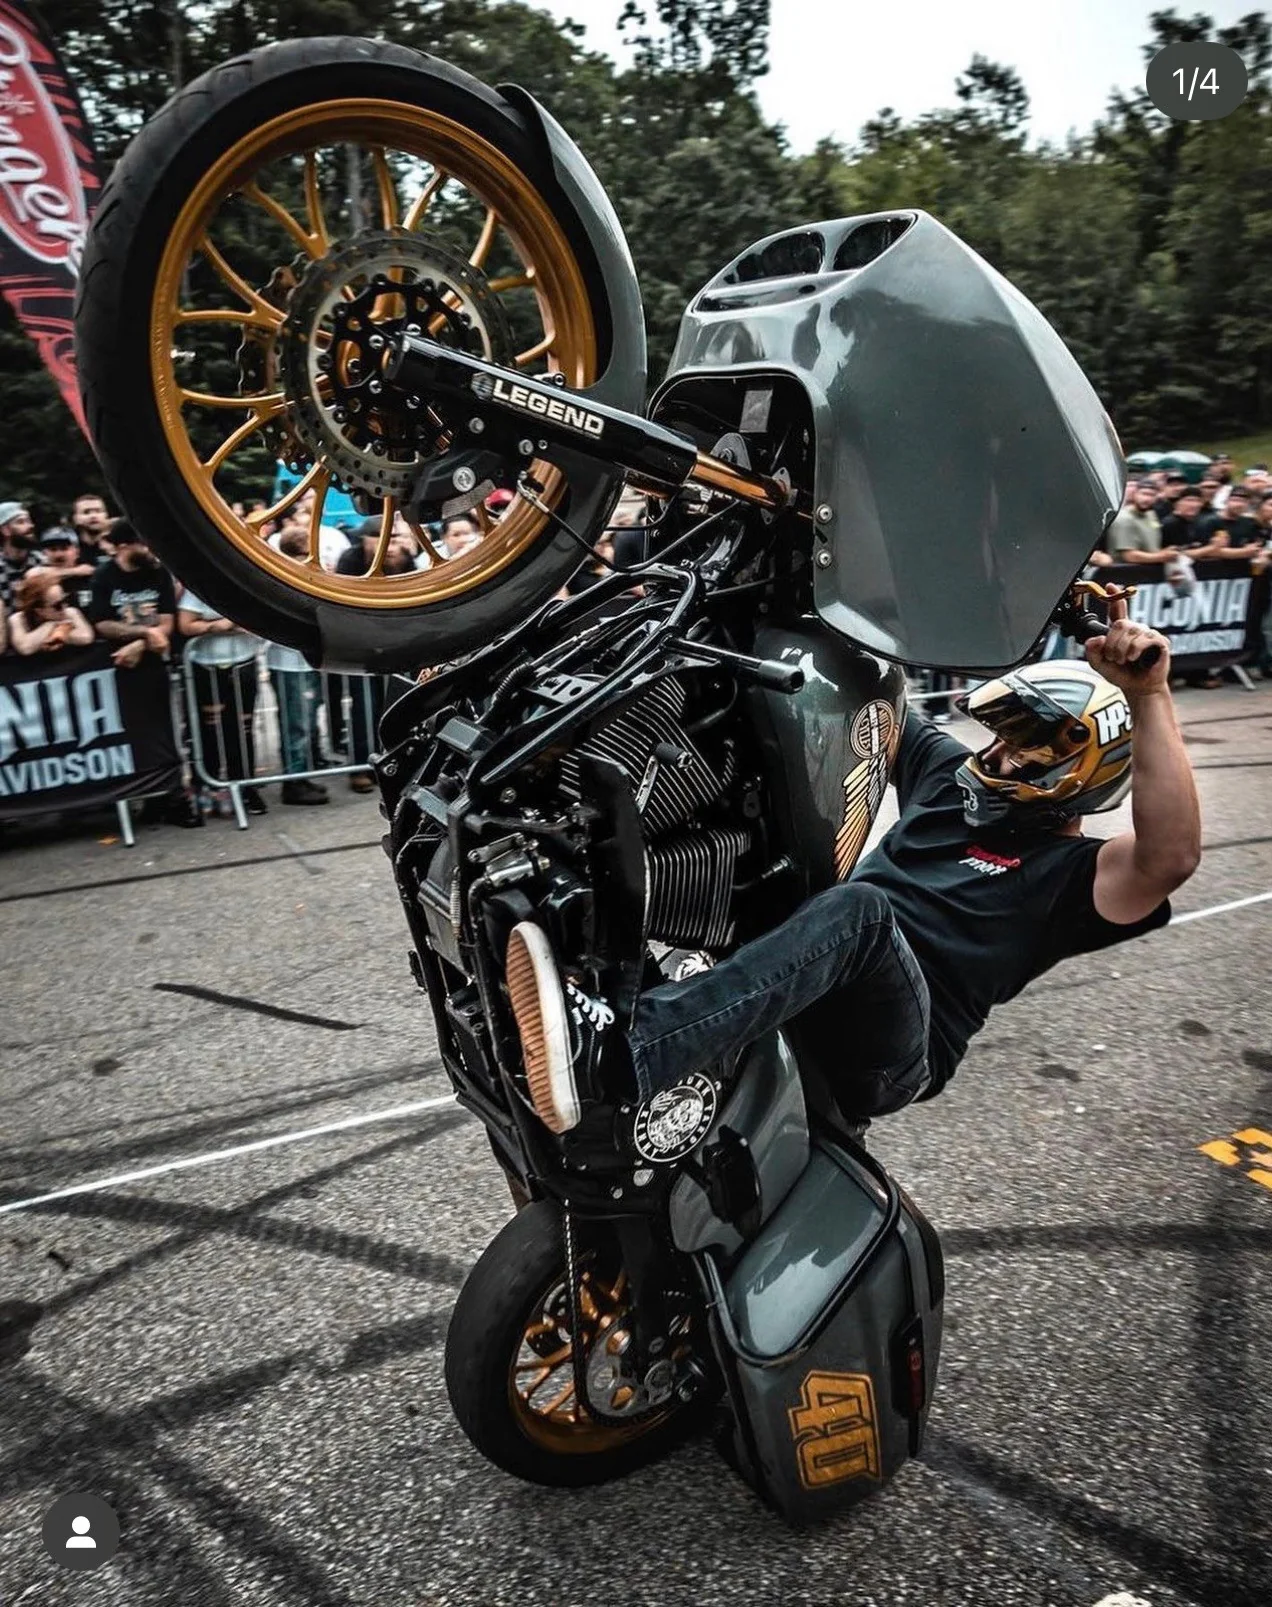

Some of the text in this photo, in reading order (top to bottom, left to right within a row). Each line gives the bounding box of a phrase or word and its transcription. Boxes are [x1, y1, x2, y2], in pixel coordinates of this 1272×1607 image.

[493, 379, 604, 435] LEGEND
[1108, 578, 1252, 631] ACONIA
[788, 1370, 882, 1490] 40
